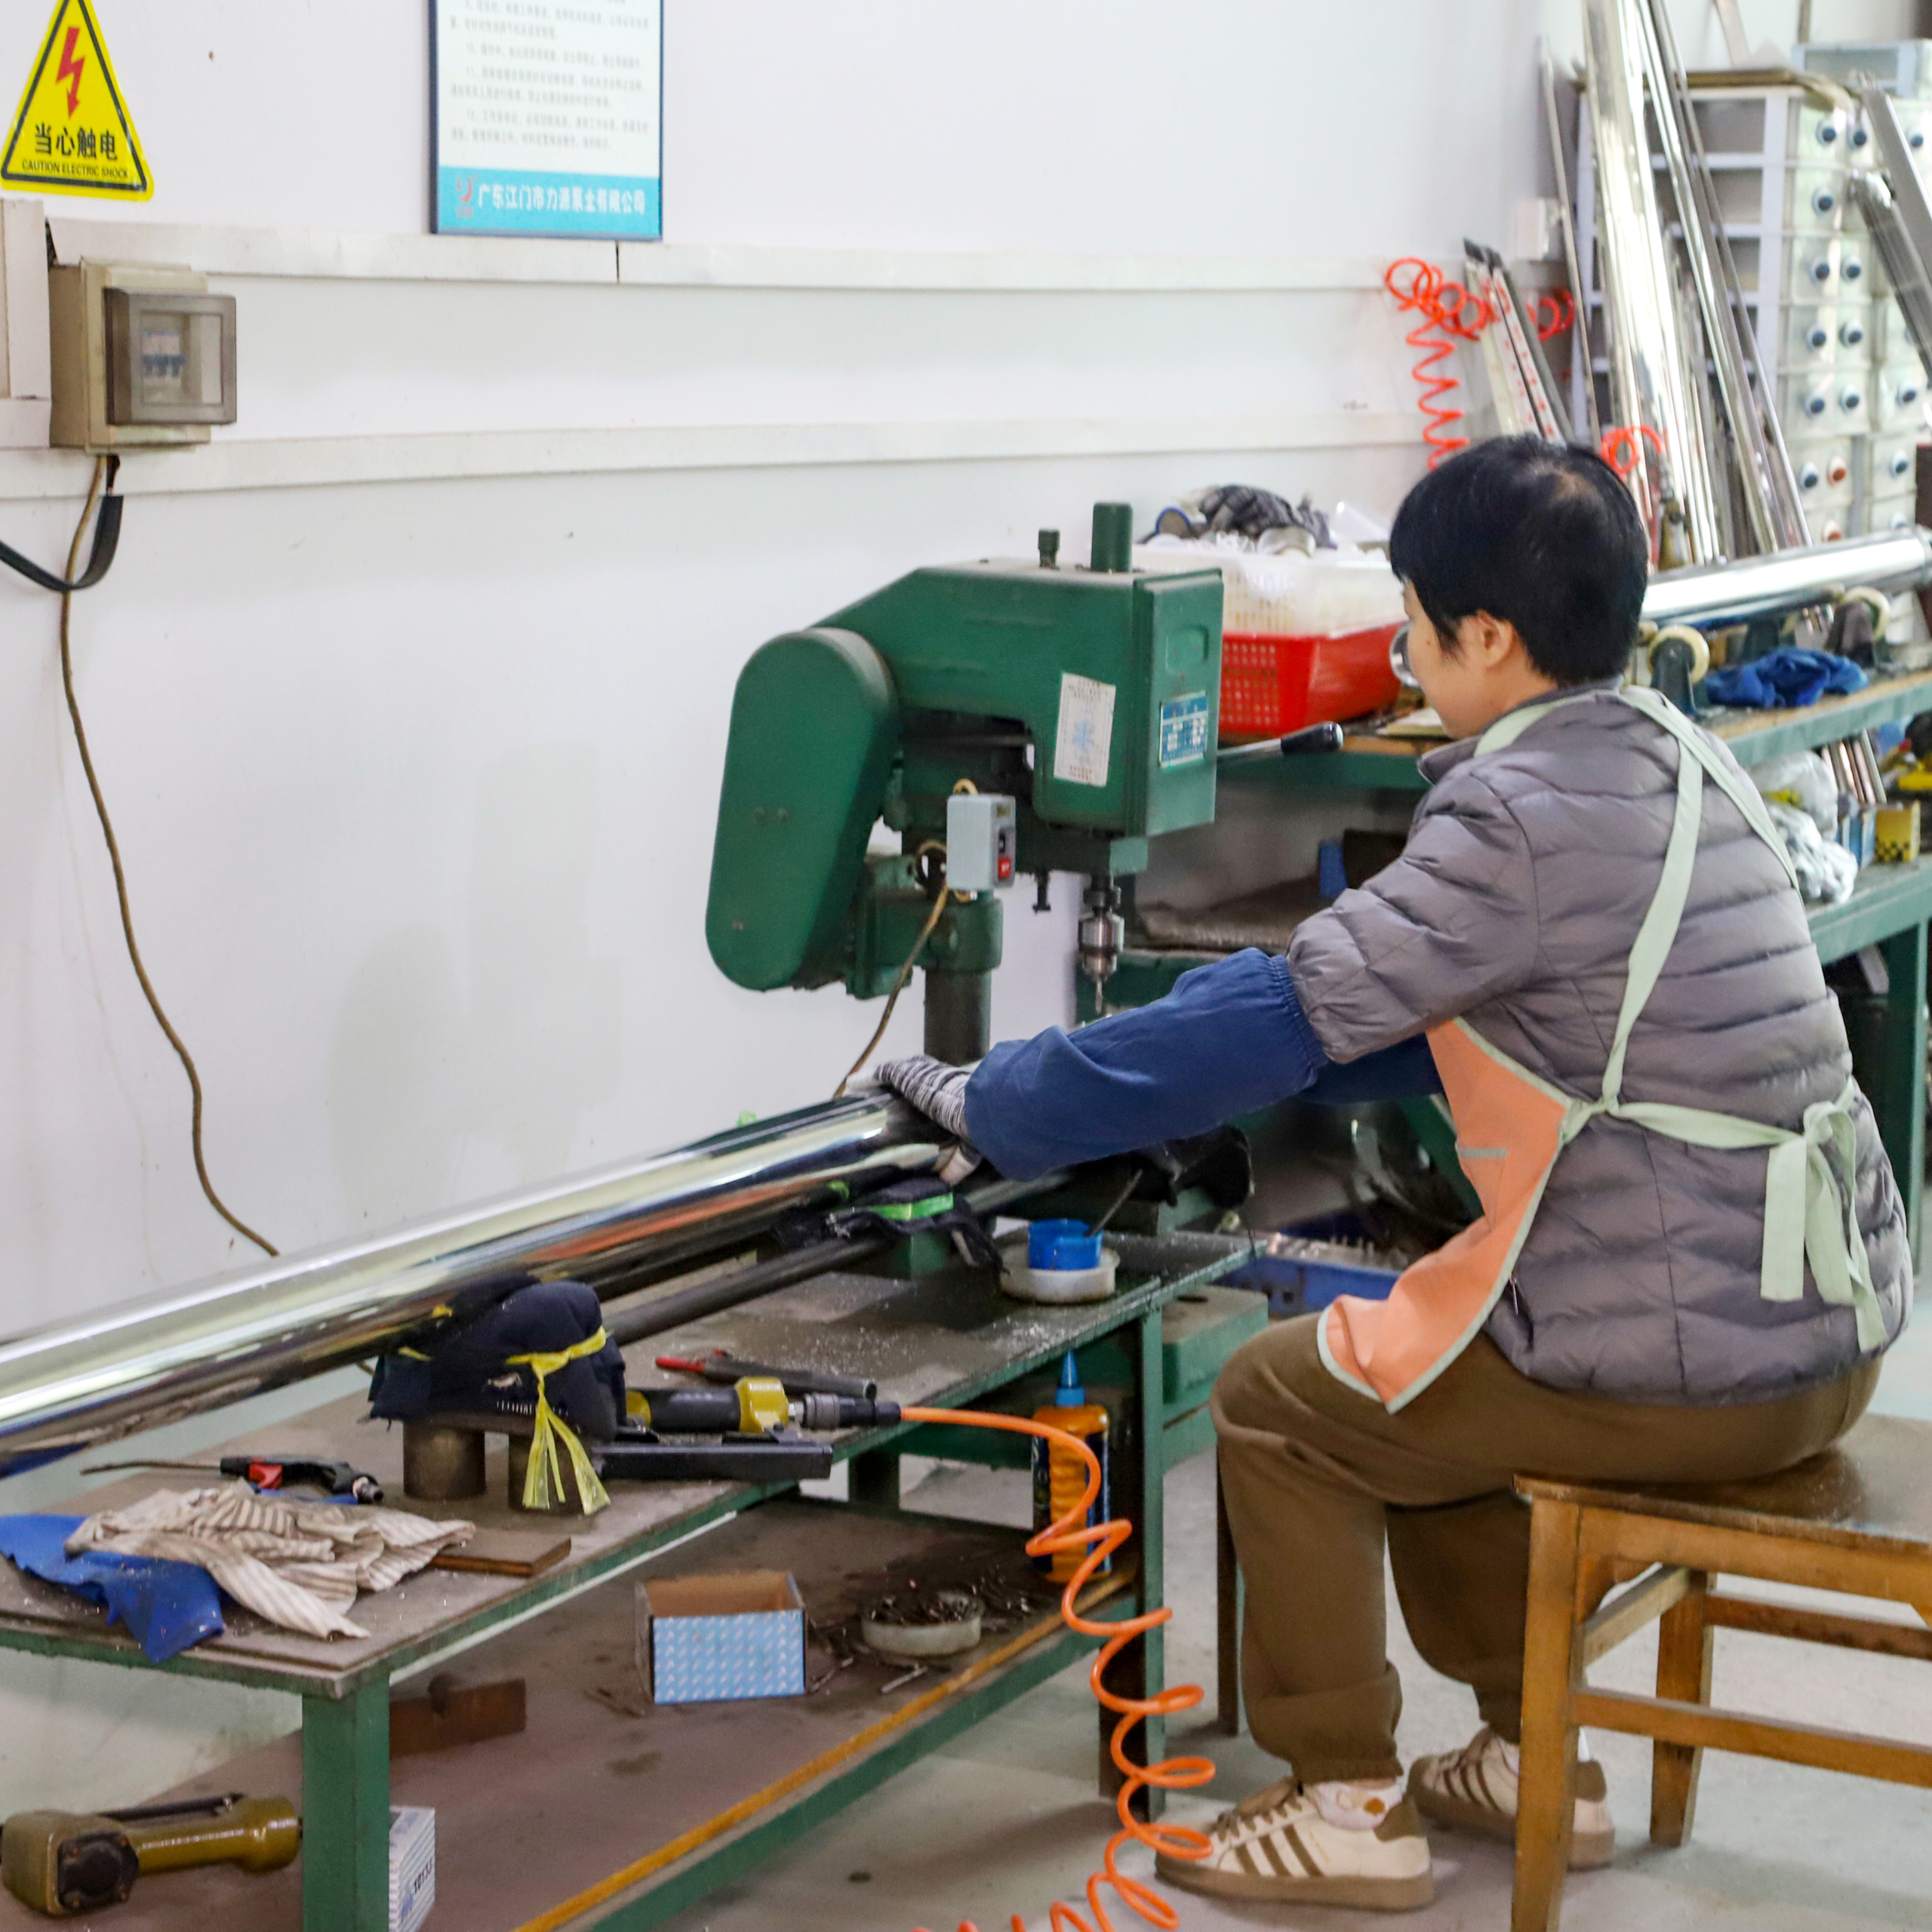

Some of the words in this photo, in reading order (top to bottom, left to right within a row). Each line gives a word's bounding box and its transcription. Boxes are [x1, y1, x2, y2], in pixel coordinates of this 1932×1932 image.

[35, 123, 117, 161] 当心触电
[22, 158, 60, 174] CAUTION
[62, 163, 99, 177] ELECTRIC
[101, 167, 128, 179] SHOCK
